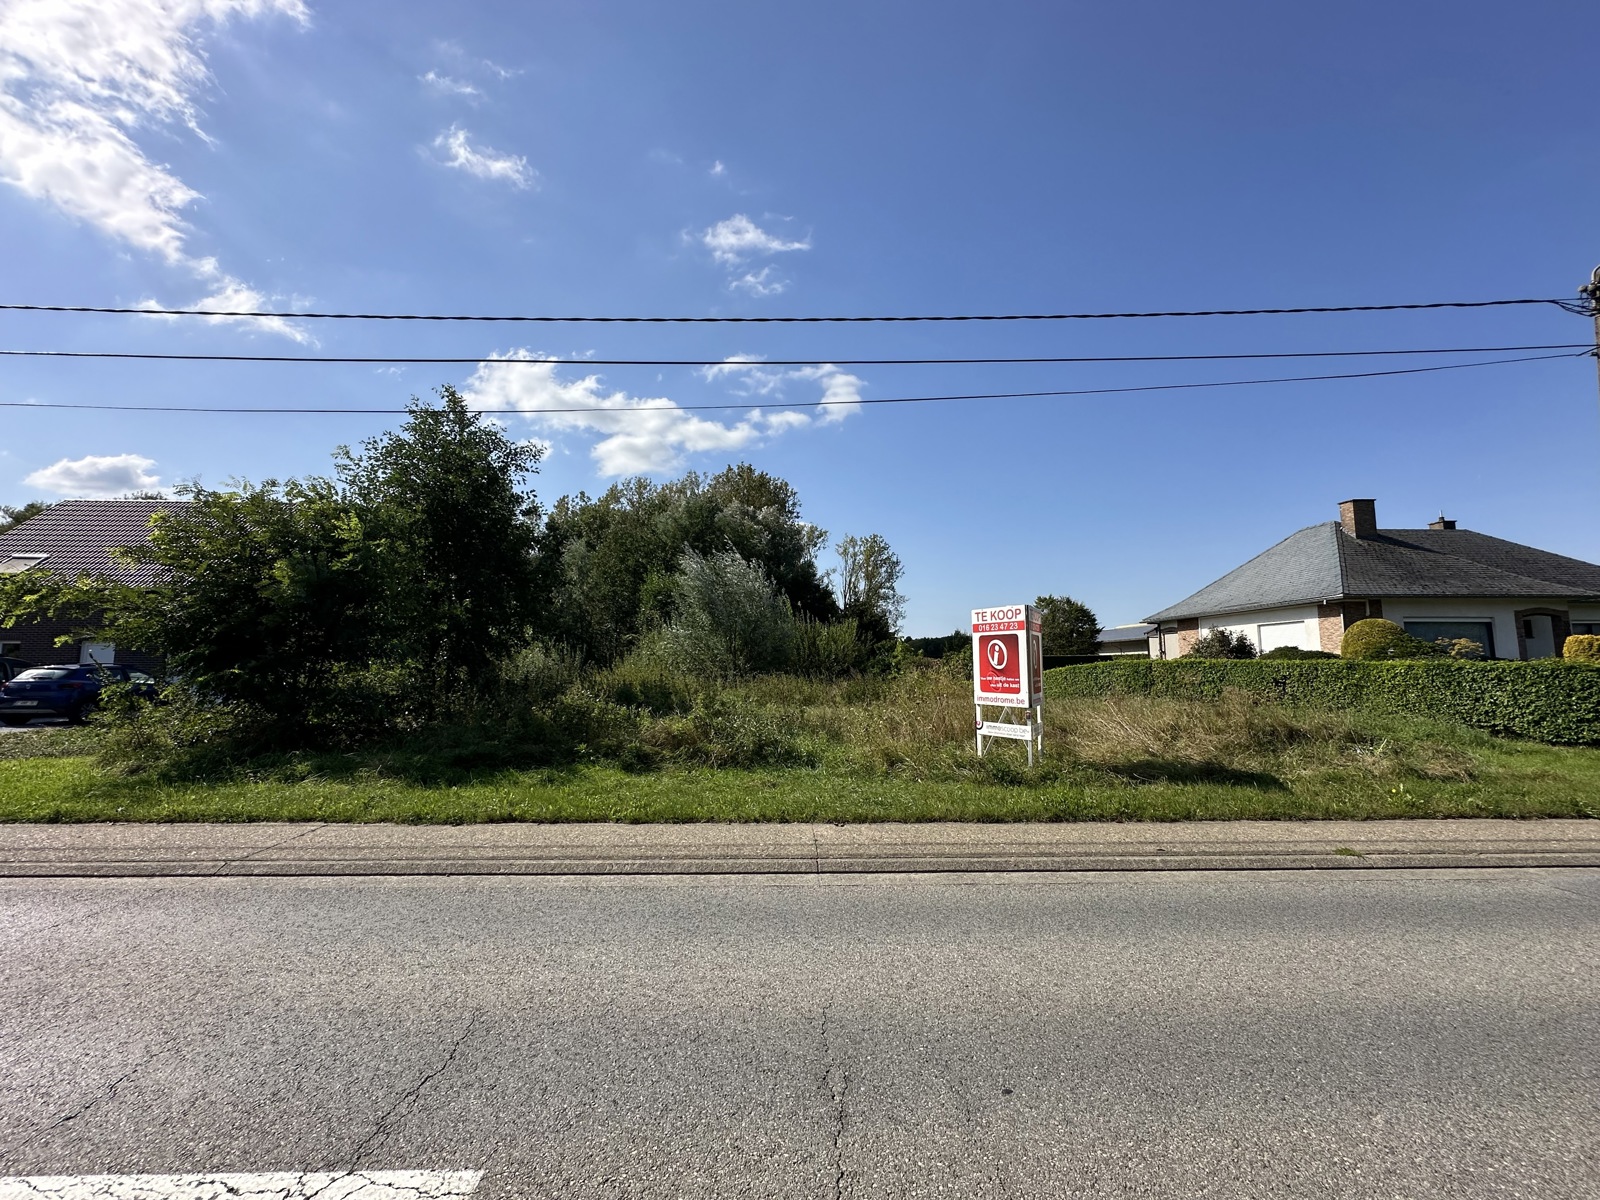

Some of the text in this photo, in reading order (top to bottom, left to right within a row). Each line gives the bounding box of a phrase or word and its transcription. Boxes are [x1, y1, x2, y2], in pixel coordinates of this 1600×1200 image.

[975, 611, 988, 622] TE
[990, 608, 1022, 621] KOOP
[990, 623, 998, 631] 23
[999, 622, 1008, 630] 47
[1009, 622, 1018, 630] 23
[977, 695, 1025, 705] immodrome.be
